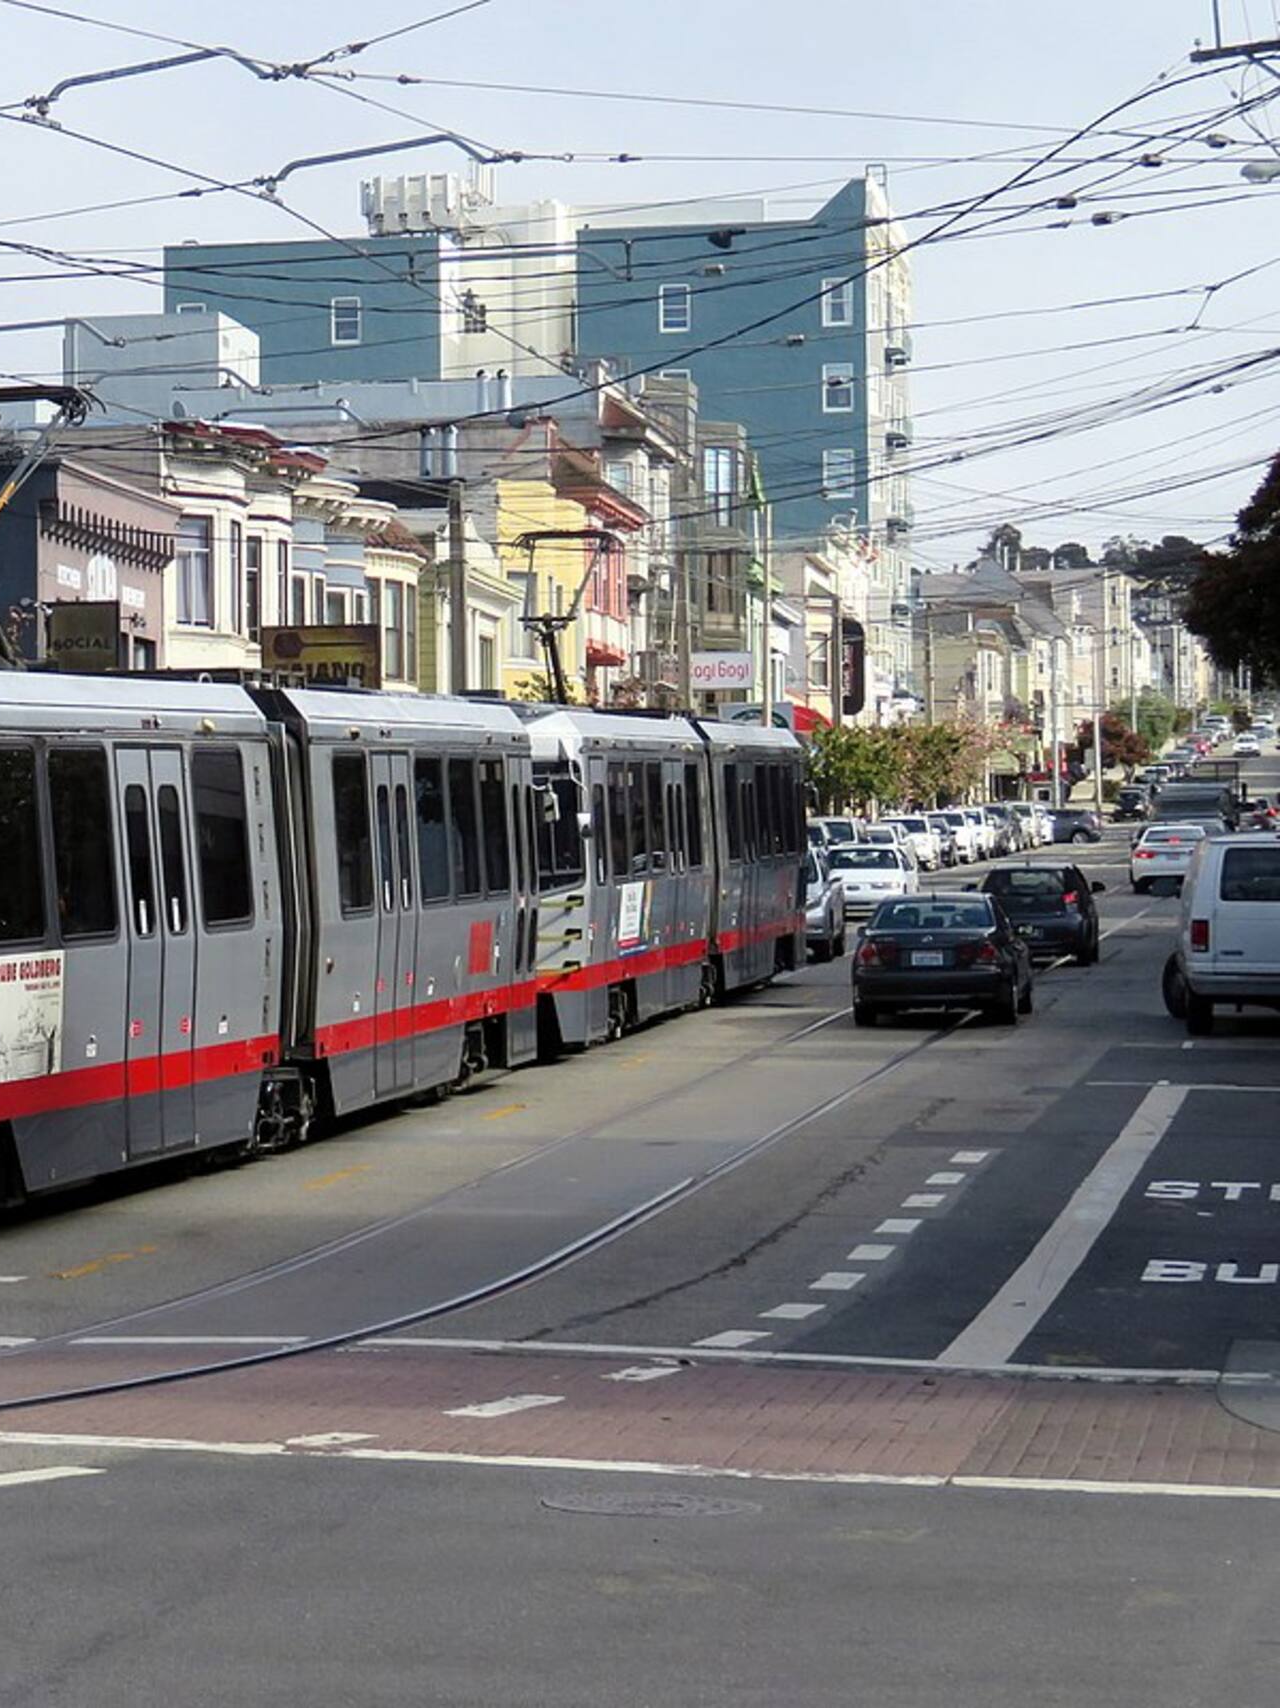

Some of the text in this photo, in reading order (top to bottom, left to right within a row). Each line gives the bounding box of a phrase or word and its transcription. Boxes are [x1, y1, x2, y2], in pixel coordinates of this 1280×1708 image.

[53, 636, 112, 651] SOCIAL
[20, 958, 61, 980] GOLDBERG
[1144, 1181, 1280, 1201] ST
